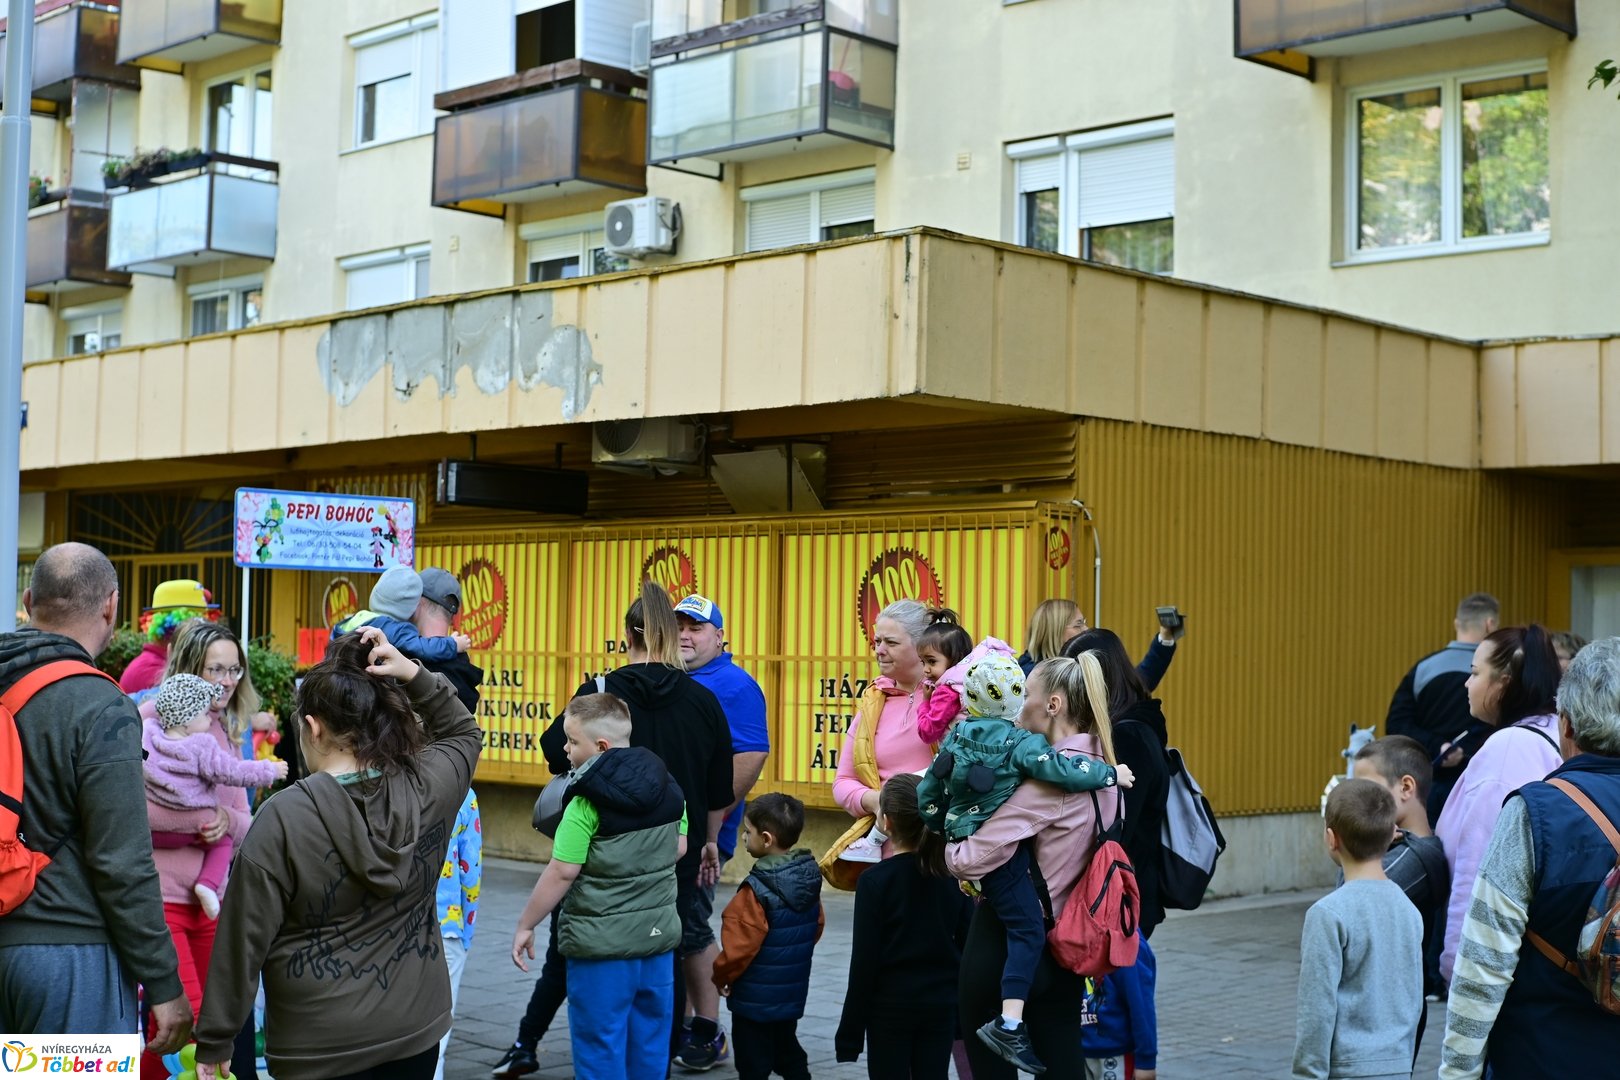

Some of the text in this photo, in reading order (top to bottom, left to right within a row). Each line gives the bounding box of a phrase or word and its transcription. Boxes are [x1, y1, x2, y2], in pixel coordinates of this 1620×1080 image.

[286, 502, 375, 523] PEPI BOHÓC
[461, 567, 493, 616] 100
